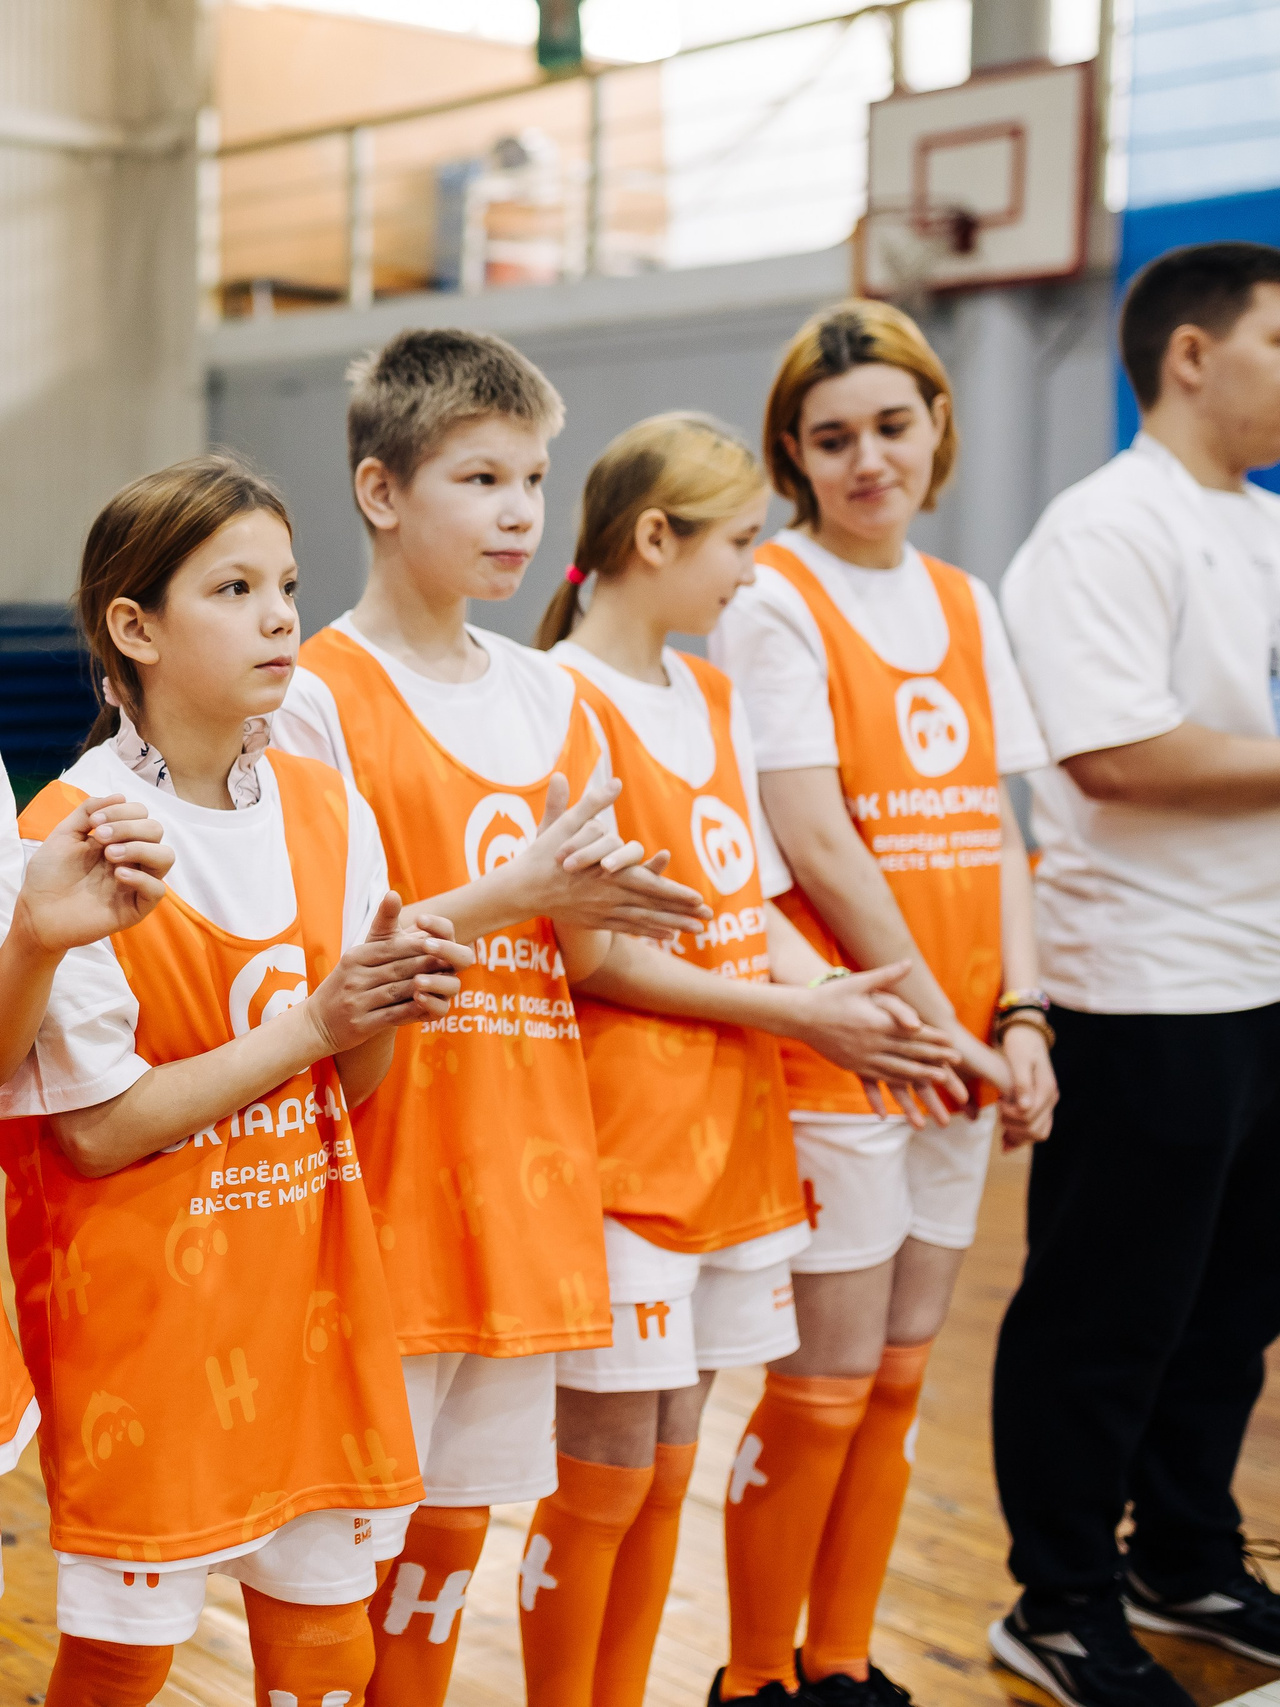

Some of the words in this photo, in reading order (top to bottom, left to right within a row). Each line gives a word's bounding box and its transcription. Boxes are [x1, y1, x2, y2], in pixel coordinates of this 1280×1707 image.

[502, 994, 515, 1012] К
[489, 1017, 520, 1036] МЫ
[294, 1157, 304, 1177] К
[278, 1180, 308, 1206] МЫ
